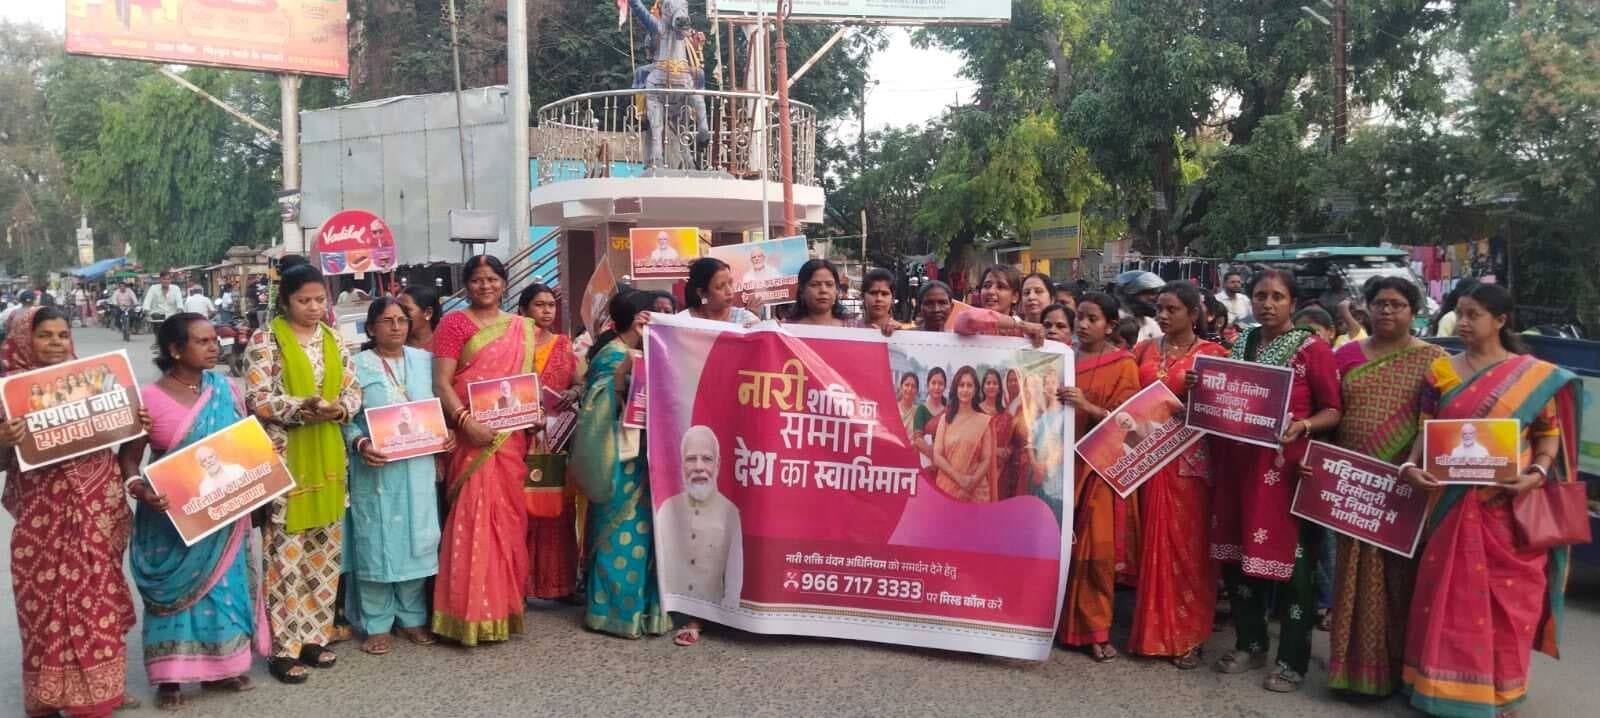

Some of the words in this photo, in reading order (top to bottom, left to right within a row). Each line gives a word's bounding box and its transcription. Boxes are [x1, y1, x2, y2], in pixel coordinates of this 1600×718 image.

[736, 358, 808, 412] नारी
[806, 383, 857, 419] शक्ति
[859, 399, 878, 418] का
[1202, 372, 1227, 391] नारी
[1226, 379, 1240, 395] को
[1240, 382, 1271, 398] मिलेगा
[1222, 407, 1243, 422] मोदी
[1244, 412, 1277, 428] सरकार
[780, 411, 880, 456] सम्मान
[733, 436, 777, 488] देश
[780, 458, 810, 489] का
[813, 455, 919, 496] स्वाभिमान
[1322, 458, 1397, 493] महिलाओं
[1395, 483, 1413, 499] की
[1320, 489, 1345, 508] राष्ट्र
[1345, 496, 1385, 520] निर्माण
[1385, 510, 1398, 525] में
[1336, 479, 1387, 507] हिस्सेदारी,
[1330, 507, 1381, 533] भागीदारी
[785, 551, 802, 564] नारी
[803, 552, 824, 565] शक्ति
[825, 553, 845, 566] वंदन
[846, 555, 887, 570] अधिनियम
[888, 560, 900, 571] को
[901, 560, 929, 573] समर्थन
[929, 563, 943, 575] देने
[944, 563, 958, 580] हेतु
[801, 572, 838, 593] 966
[843, 575, 873, 595] 717
[876, 578, 922, 600] 3333
[926, 593, 938, 604] पर
[939, 591, 962, 607] मिस्ड
[963, 592, 986, 609] कॉल
